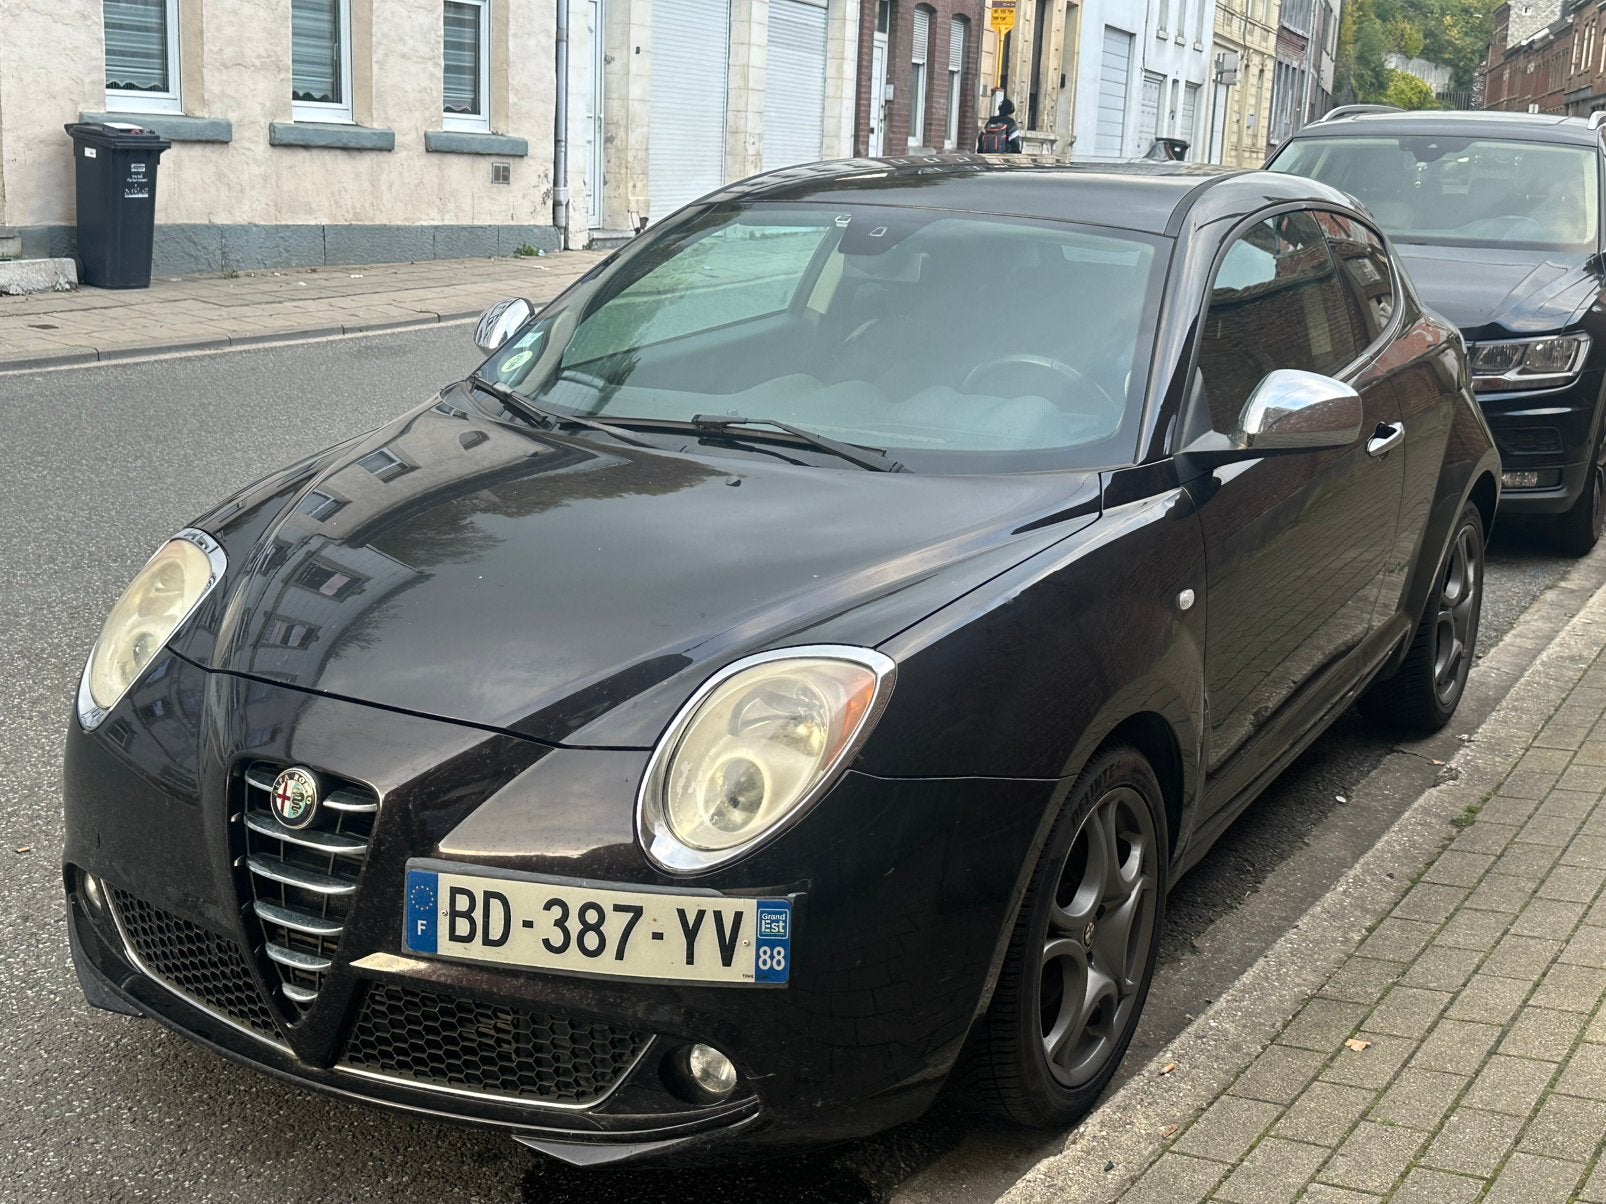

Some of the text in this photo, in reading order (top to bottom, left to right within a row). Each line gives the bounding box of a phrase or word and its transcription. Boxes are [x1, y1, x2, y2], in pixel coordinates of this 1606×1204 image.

[417, 920, 427, 936] F
[449, 886, 744, 967] BD-387-YV
[761, 920, 785, 933] Est
[758, 946, 785, 971] 88
